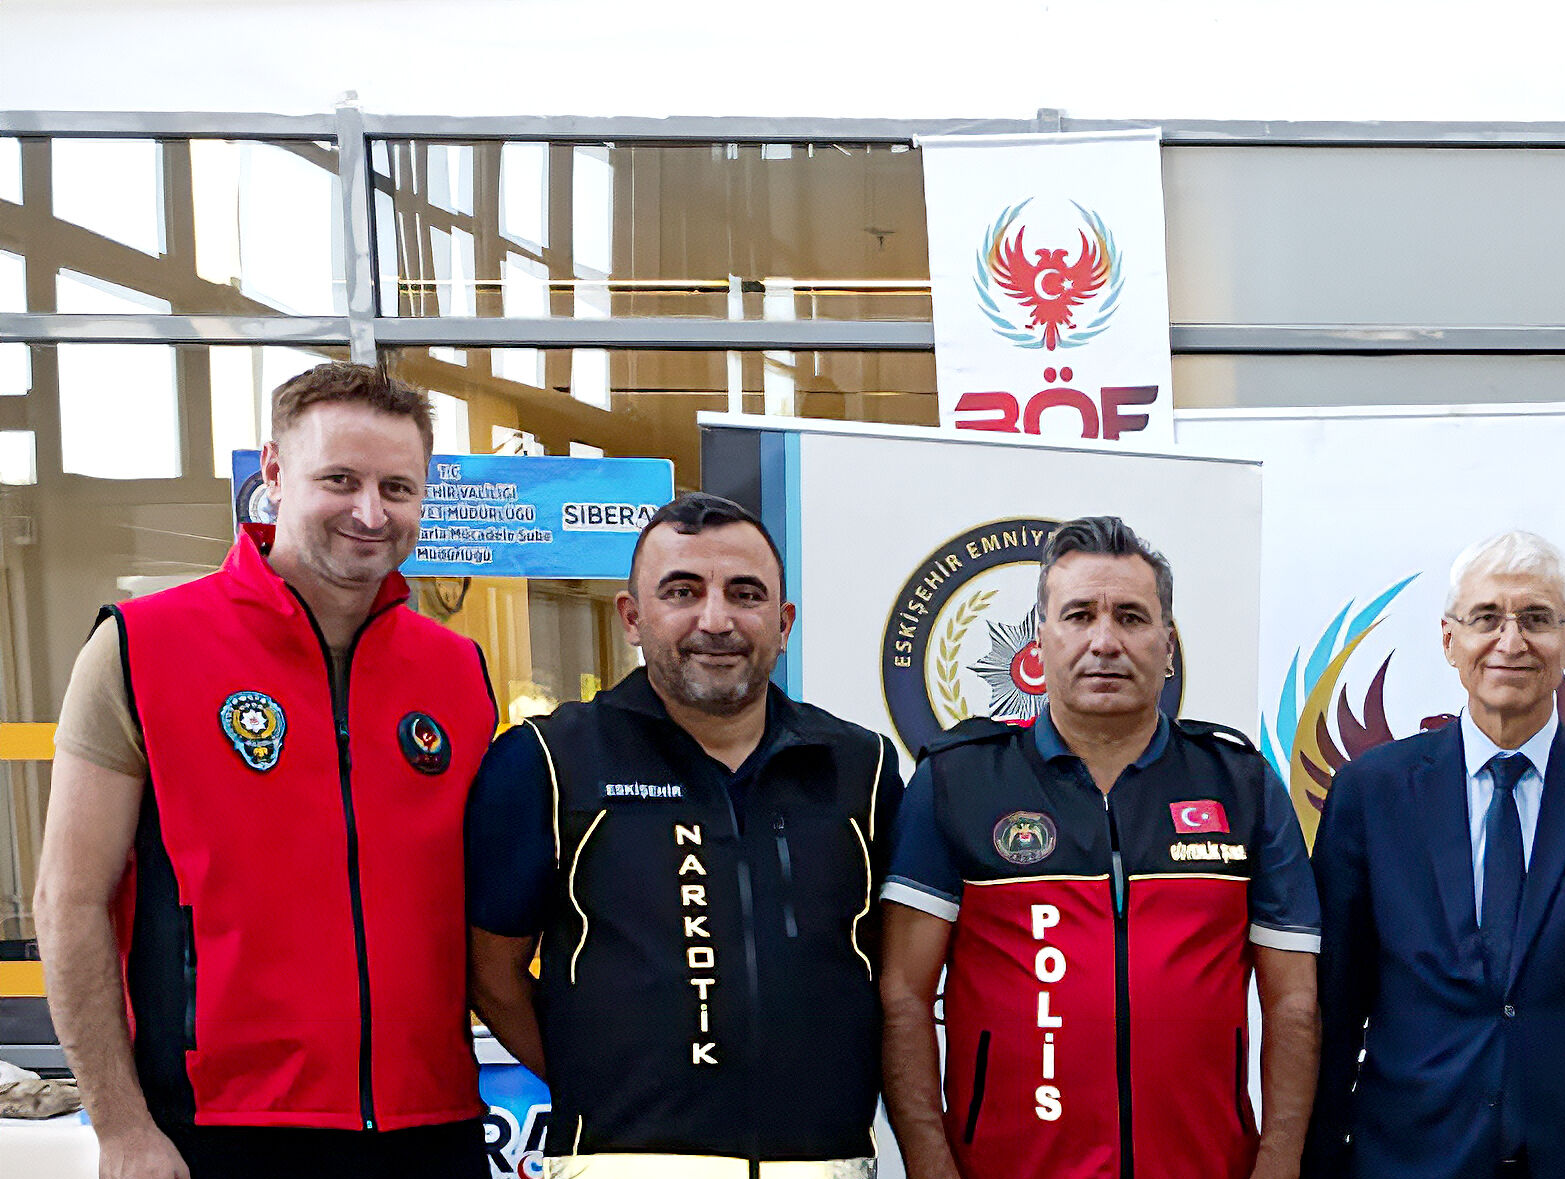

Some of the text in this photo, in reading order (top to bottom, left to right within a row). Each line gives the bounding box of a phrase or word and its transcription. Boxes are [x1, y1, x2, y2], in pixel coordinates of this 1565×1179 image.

[894, 552, 963, 668] ESKİŞEHİR
[674, 824, 719, 1066] NARKOTİK
[1030, 904, 1067, 1121] POLİS
